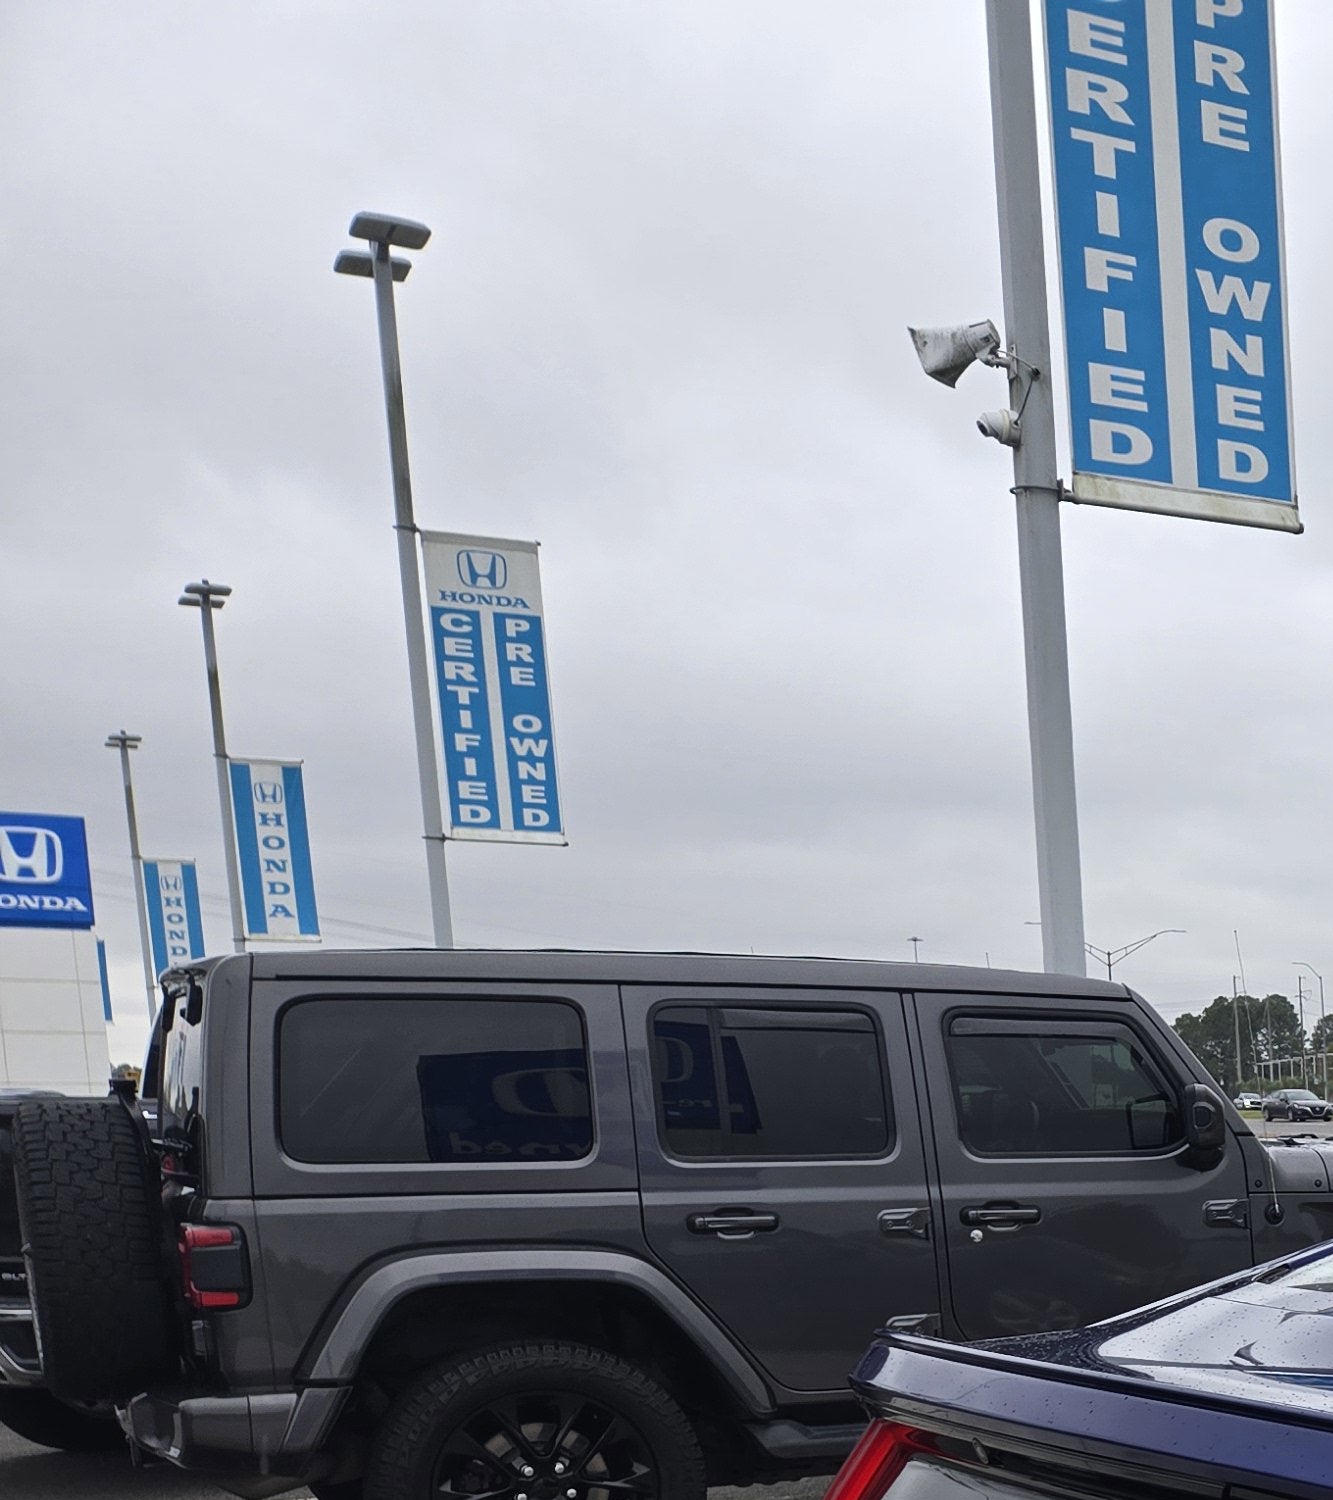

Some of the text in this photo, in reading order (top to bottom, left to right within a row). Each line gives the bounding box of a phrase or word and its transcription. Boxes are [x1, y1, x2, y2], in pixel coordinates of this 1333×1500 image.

[1066, 0, 1153, 465] ERTIFIED
[1195, 217, 1271, 484] OWNED
[438, 590, 530, 609] HONDA
[440, 612, 491, 824] CERTIFIED
[505, 617, 550, 828] PRE OWNED
[0, 893, 89, 912] ONDA
[164, 896, 188, 964] HOND
[258, 812, 295, 918] HONDA
